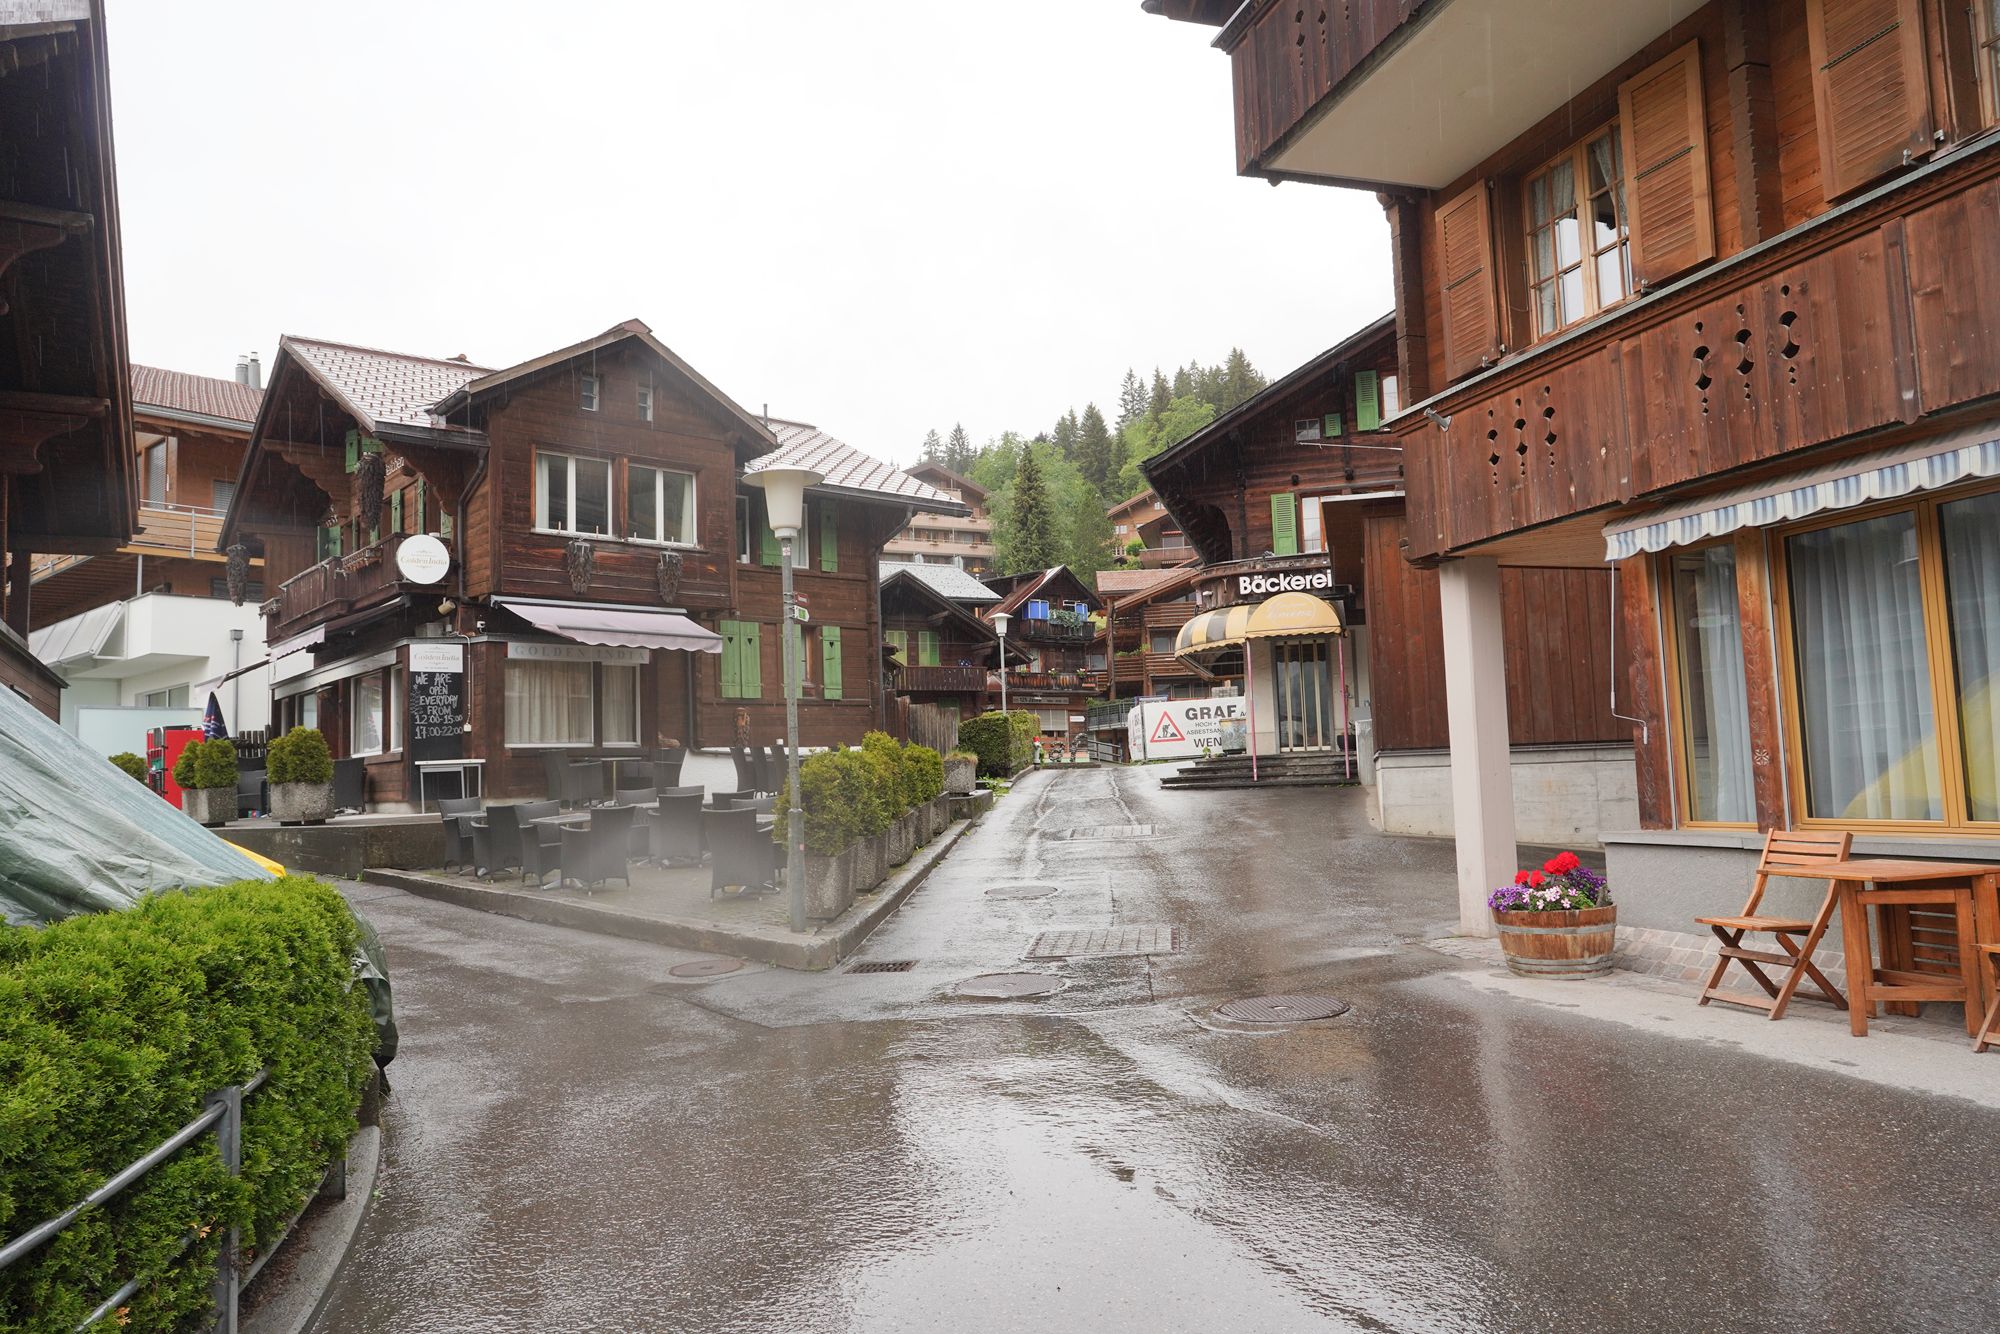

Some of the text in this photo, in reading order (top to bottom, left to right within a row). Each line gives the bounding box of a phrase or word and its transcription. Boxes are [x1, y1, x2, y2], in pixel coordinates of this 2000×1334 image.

[1239, 569, 1332, 595] Bäckerei
[515, 645, 645, 661] GOLDEN INDIA
[415, 672, 452, 686] WE ARE
[429, 685, 448, 695] OPEN
[419, 695, 458, 708] EVERYDAY
[427, 706, 451, 716] FROM
[1185, 705, 1236, 720] GRAF
